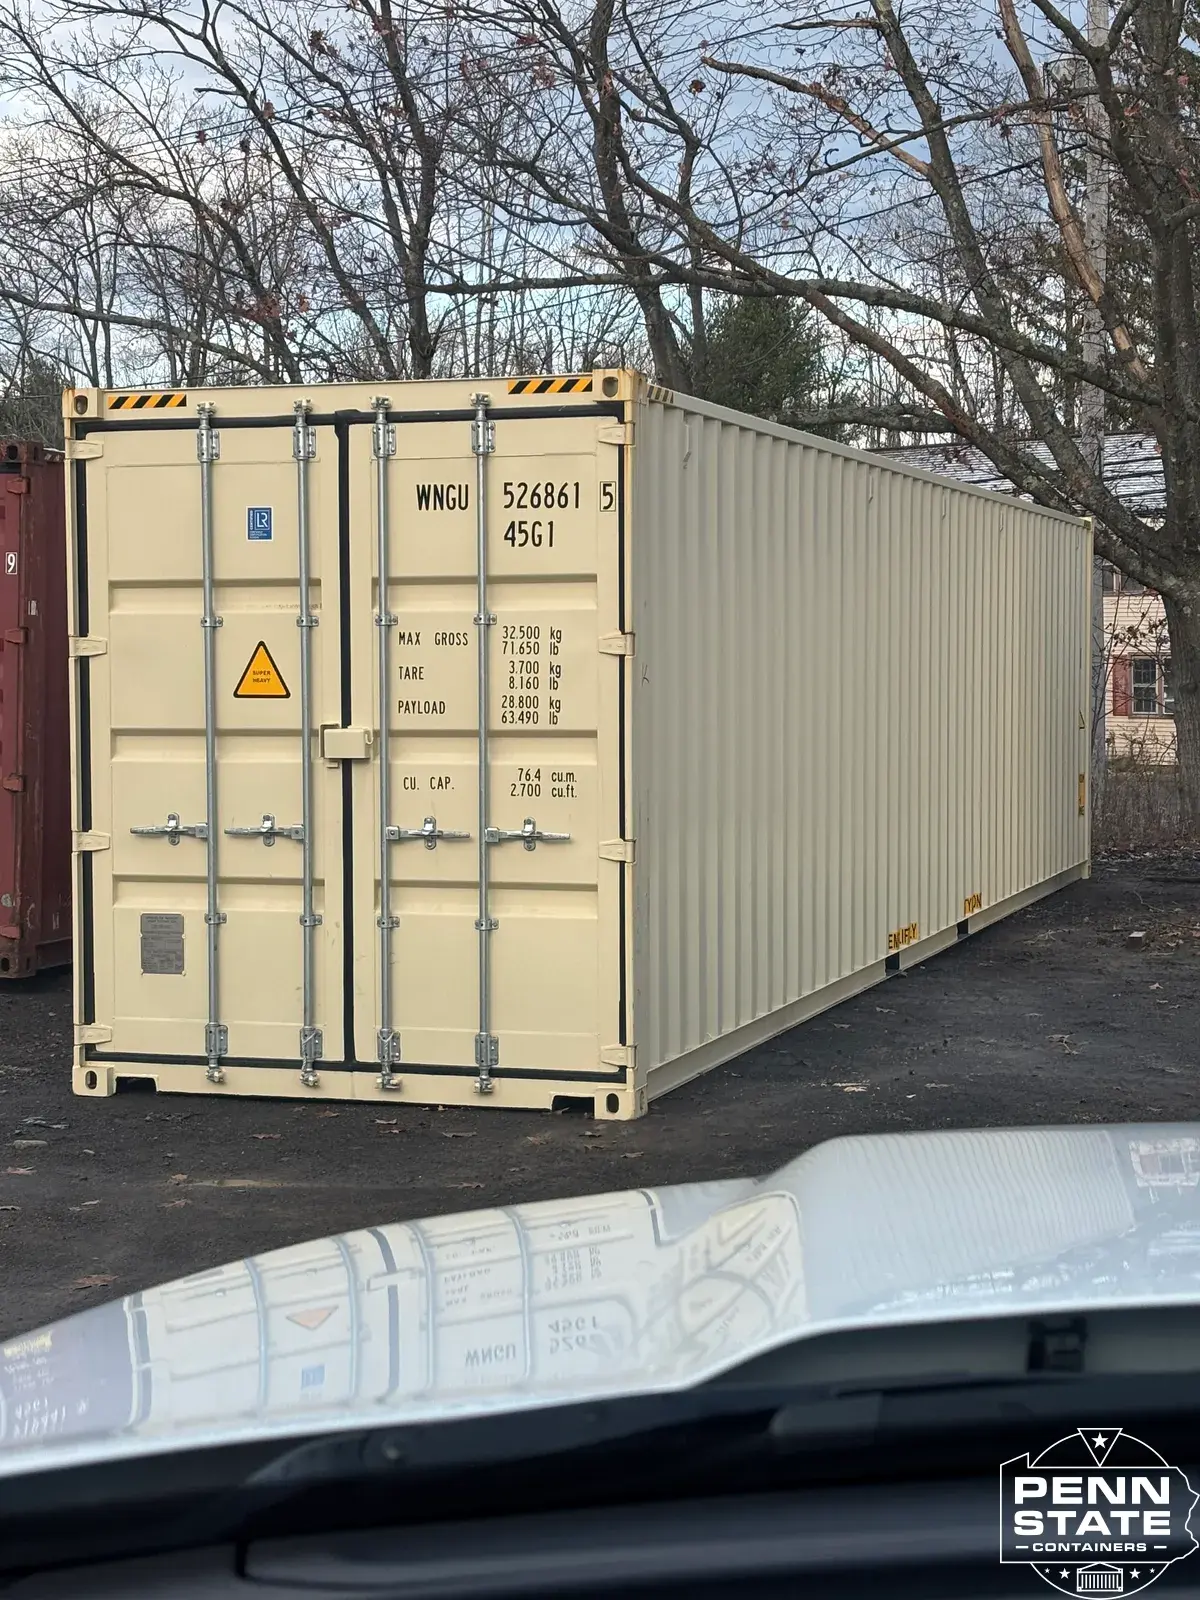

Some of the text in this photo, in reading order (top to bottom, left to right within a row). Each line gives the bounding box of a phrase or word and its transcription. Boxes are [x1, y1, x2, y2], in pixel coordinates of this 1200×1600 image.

[416, 481, 615, 512] WNGU 526861 5
[503, 520, 555, 548] 45G1
[7, 553, 16, 573] 9
[398, 631, 469, 647] MAX GROSS
[502, 625, 563, 643] 32.500 kg
[502, 641, 559, 656] 71.650 lb
[398, 666, 425, 681] TARE
[508, 660, 562, 678] 3.700 kg
[508, 676, 559, 691] 8.160 lb
[397, 700, 447, 716] PAYLOAD
[501, 695, 562, 713] 28.800 kg
[501, 710, 559, 726] 63.490 lb
[403, 776, 455, 791] CU. CAP.
[517, 768, 577, 784] 76.4 cu.m.
[510, 783, 577, 799] 2.700 cu.ft.
